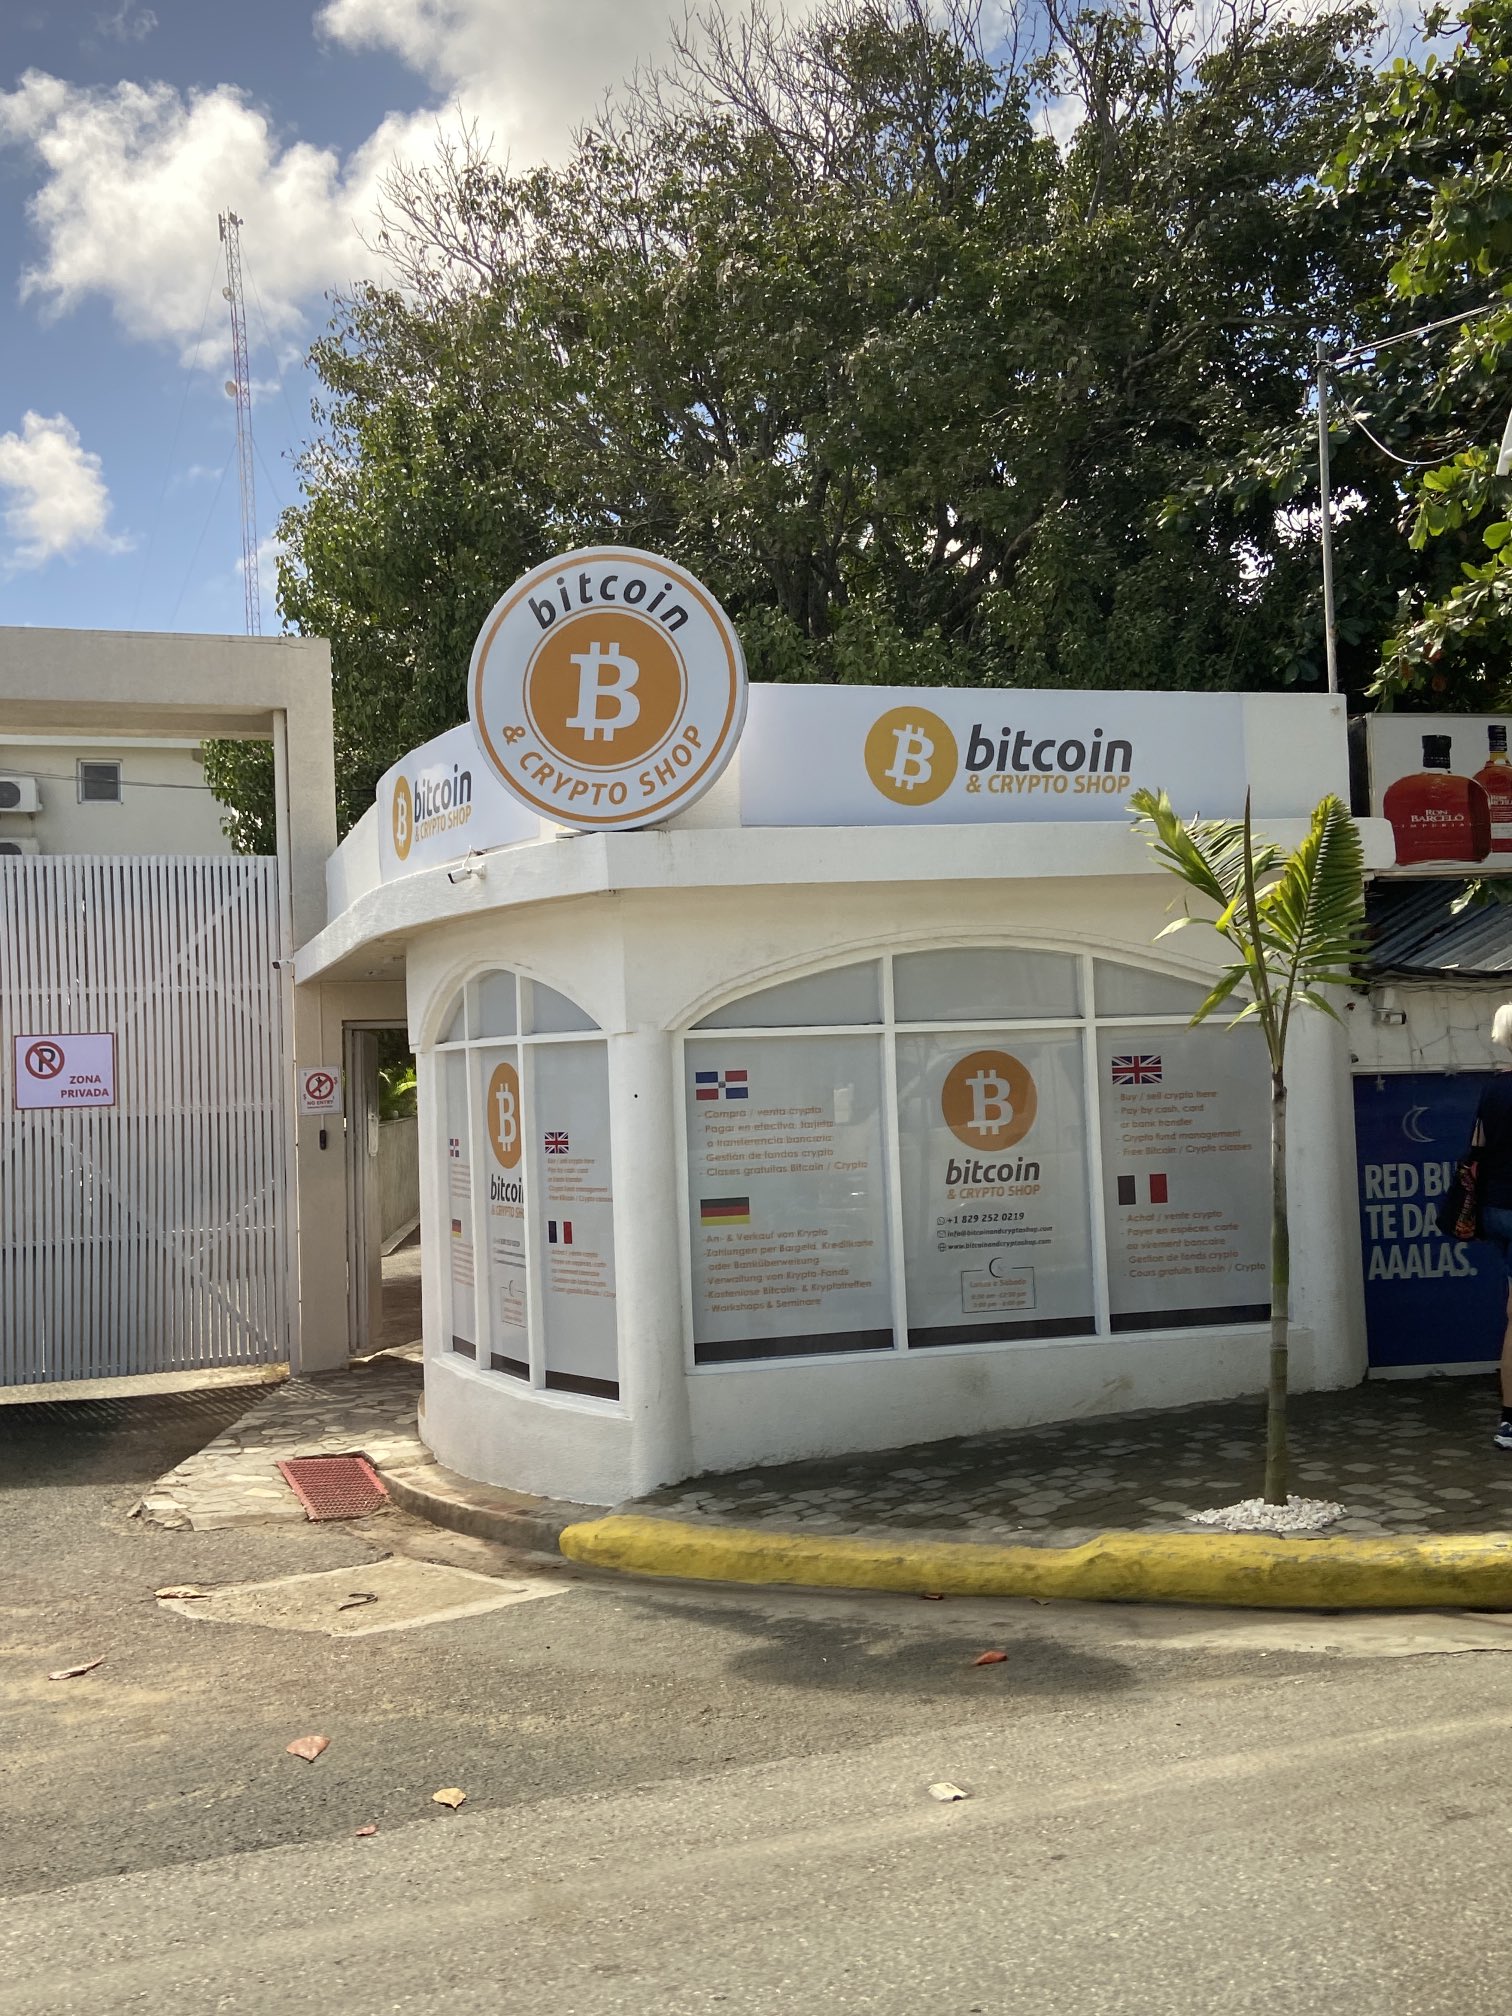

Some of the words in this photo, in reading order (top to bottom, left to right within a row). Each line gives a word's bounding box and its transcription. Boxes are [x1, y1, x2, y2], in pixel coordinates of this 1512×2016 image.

[527, 572, 689, 632] bitcoin
[964, 723, 1133, 773] bitcoin
[502, 725, 527, 746] &
[519, 751, 628, 806] CRYPTO
[639, 724, 702, 797] SHOP
[966, 774, 981, 794] &
[988, 774, 1068, 794] CRYPTO
[1073, 774, 1131, 794] SHOP
[414, 763, 472, 823] bitcoin
[415, 827, 420, 842] &
[420, 814, 447, 840] CRYPTO
[448, 804, 472, 829] SHOP
[69, 1075, 102, 1085] ZONA
[60, 1088, 109, 1098] PRIVADA
[1164, 1091, 1193, 1101] crypto
[704, 1109, 747, 1119] Compra
[757, 1108, 786, 1116] venta
[789, 1106, 823, 1117] crypto
[705, 1124, 735, 1135] Pagar
[801, 1148, 834, 1159] crypto
[707, 1167, 741, 1176] Clases
[790, 1163, 824, 1173] Bitcoin
[945, 1156, 1040, 1185] bitcoin
[1364, 1163, 1419, 1199] RED
[947, 1188, 957, 1200] &
[959, 1186, 1005, 1199] CRYPTO
[1007, 1184, 1041, 1198] SHOP
[947, 1216, 958, 1224] +1
[961, 1214, 979, 1224] 829
[981, 1213, 999, 1222] 252
[1001, 1212, 1025, 1221] 0219
[1365, 1204, 1398, 1240] TE
[1402, 1202, 1442, 1239] DA
[736, 1231, 774, 1242] Verkauf
[797, 1229, 828, 1239] Krypto
[1234, 1262, 1266, 1272] Crypto
[1368, 1241, 1478, 1281] AAALAS.
[711, 1301, 765, 1312] Workshops
